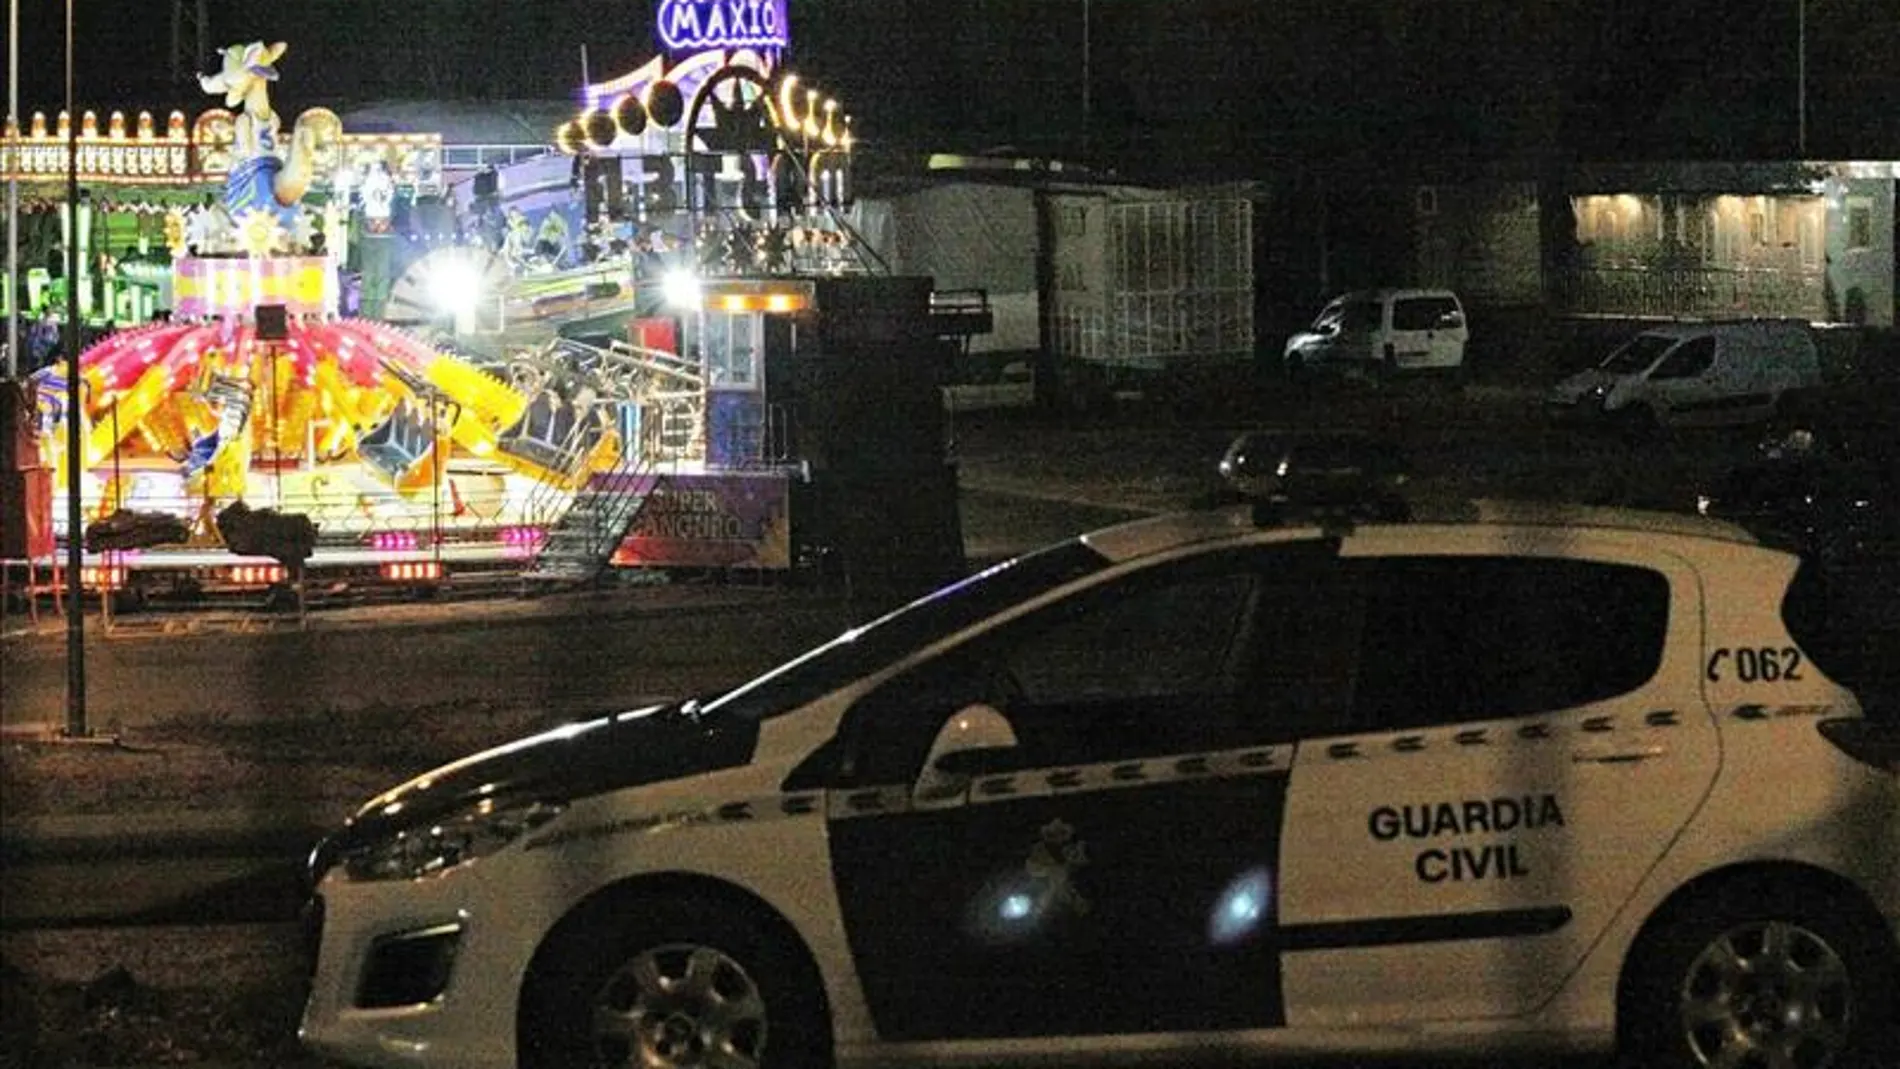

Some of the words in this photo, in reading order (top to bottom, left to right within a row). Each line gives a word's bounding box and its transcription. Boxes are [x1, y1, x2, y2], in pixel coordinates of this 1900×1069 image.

[652, 488, 720, 513] SUPER
[1736, 646, 1803, 682] 062
[1368, 795, 1566, 842] GUARDIA
[1415, 845, 1530, 883] CIVIL
